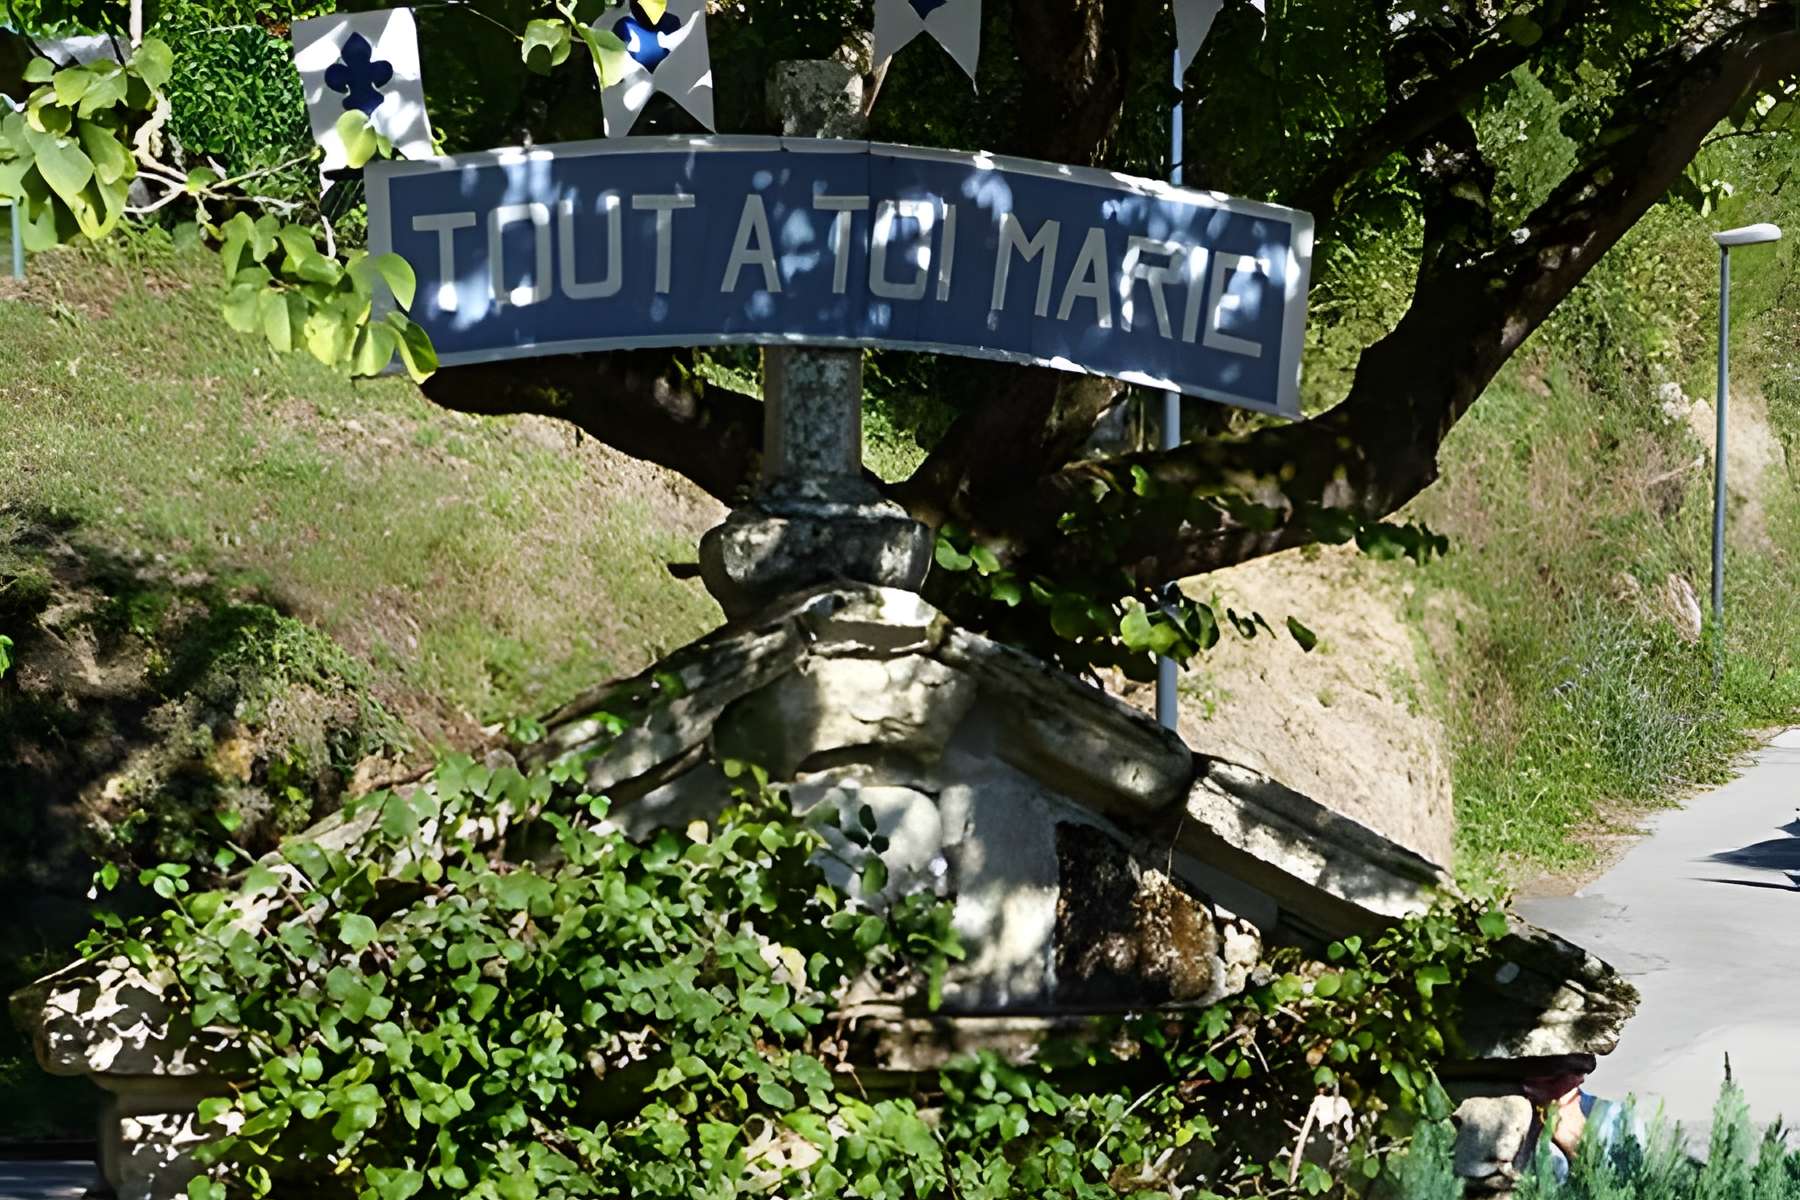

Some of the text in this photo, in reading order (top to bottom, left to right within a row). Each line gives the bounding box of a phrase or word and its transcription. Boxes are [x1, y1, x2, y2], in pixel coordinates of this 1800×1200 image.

[412, 193, 1263, 359] TOUT A TOI MARIE
